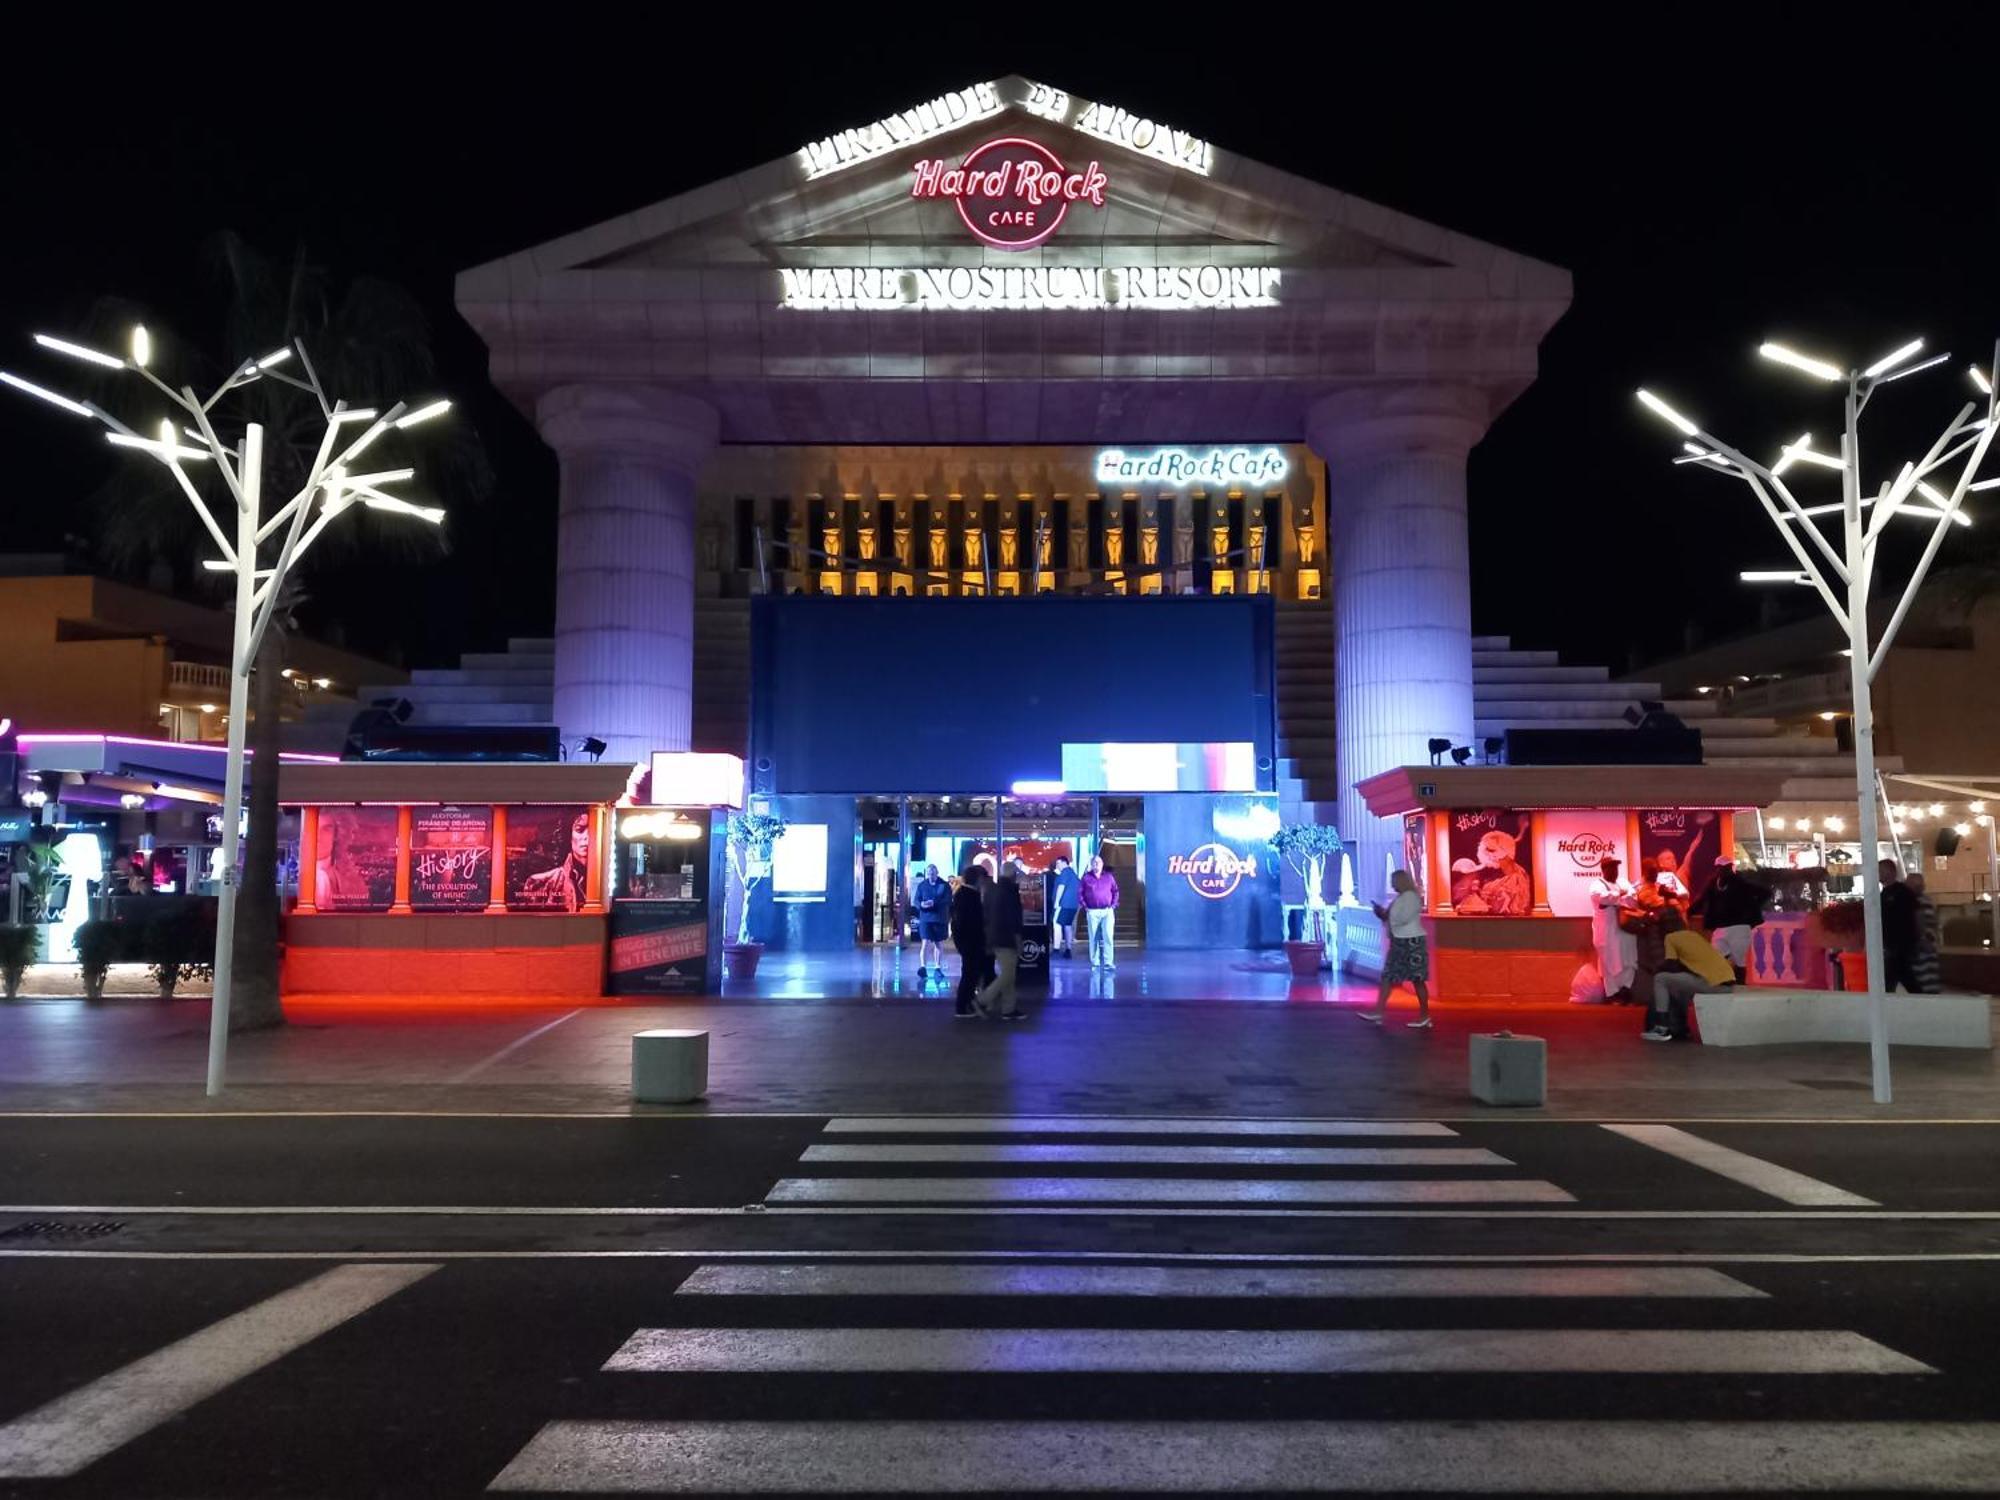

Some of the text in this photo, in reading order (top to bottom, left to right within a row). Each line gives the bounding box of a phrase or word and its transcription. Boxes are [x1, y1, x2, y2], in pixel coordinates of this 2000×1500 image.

[1029, 82, 1067, 114] DE
[1076, 101, 1209, 171] ARONA
[912, 159, 1107, 206] Hard Rock
[988, 211, 1035, 226] CAFE
[784, 265, 1272, 302] MARE NOSTRUM RESORT
[1167, 452, 1223, 482] Rock
[1227, 452, 1284, 481] Cafe
[1557, 840, 1615, 854] Hard Rock
[1168, 853, 1257, 878] Hard Rock
[1202, 879, 1225, 888] CAFE
